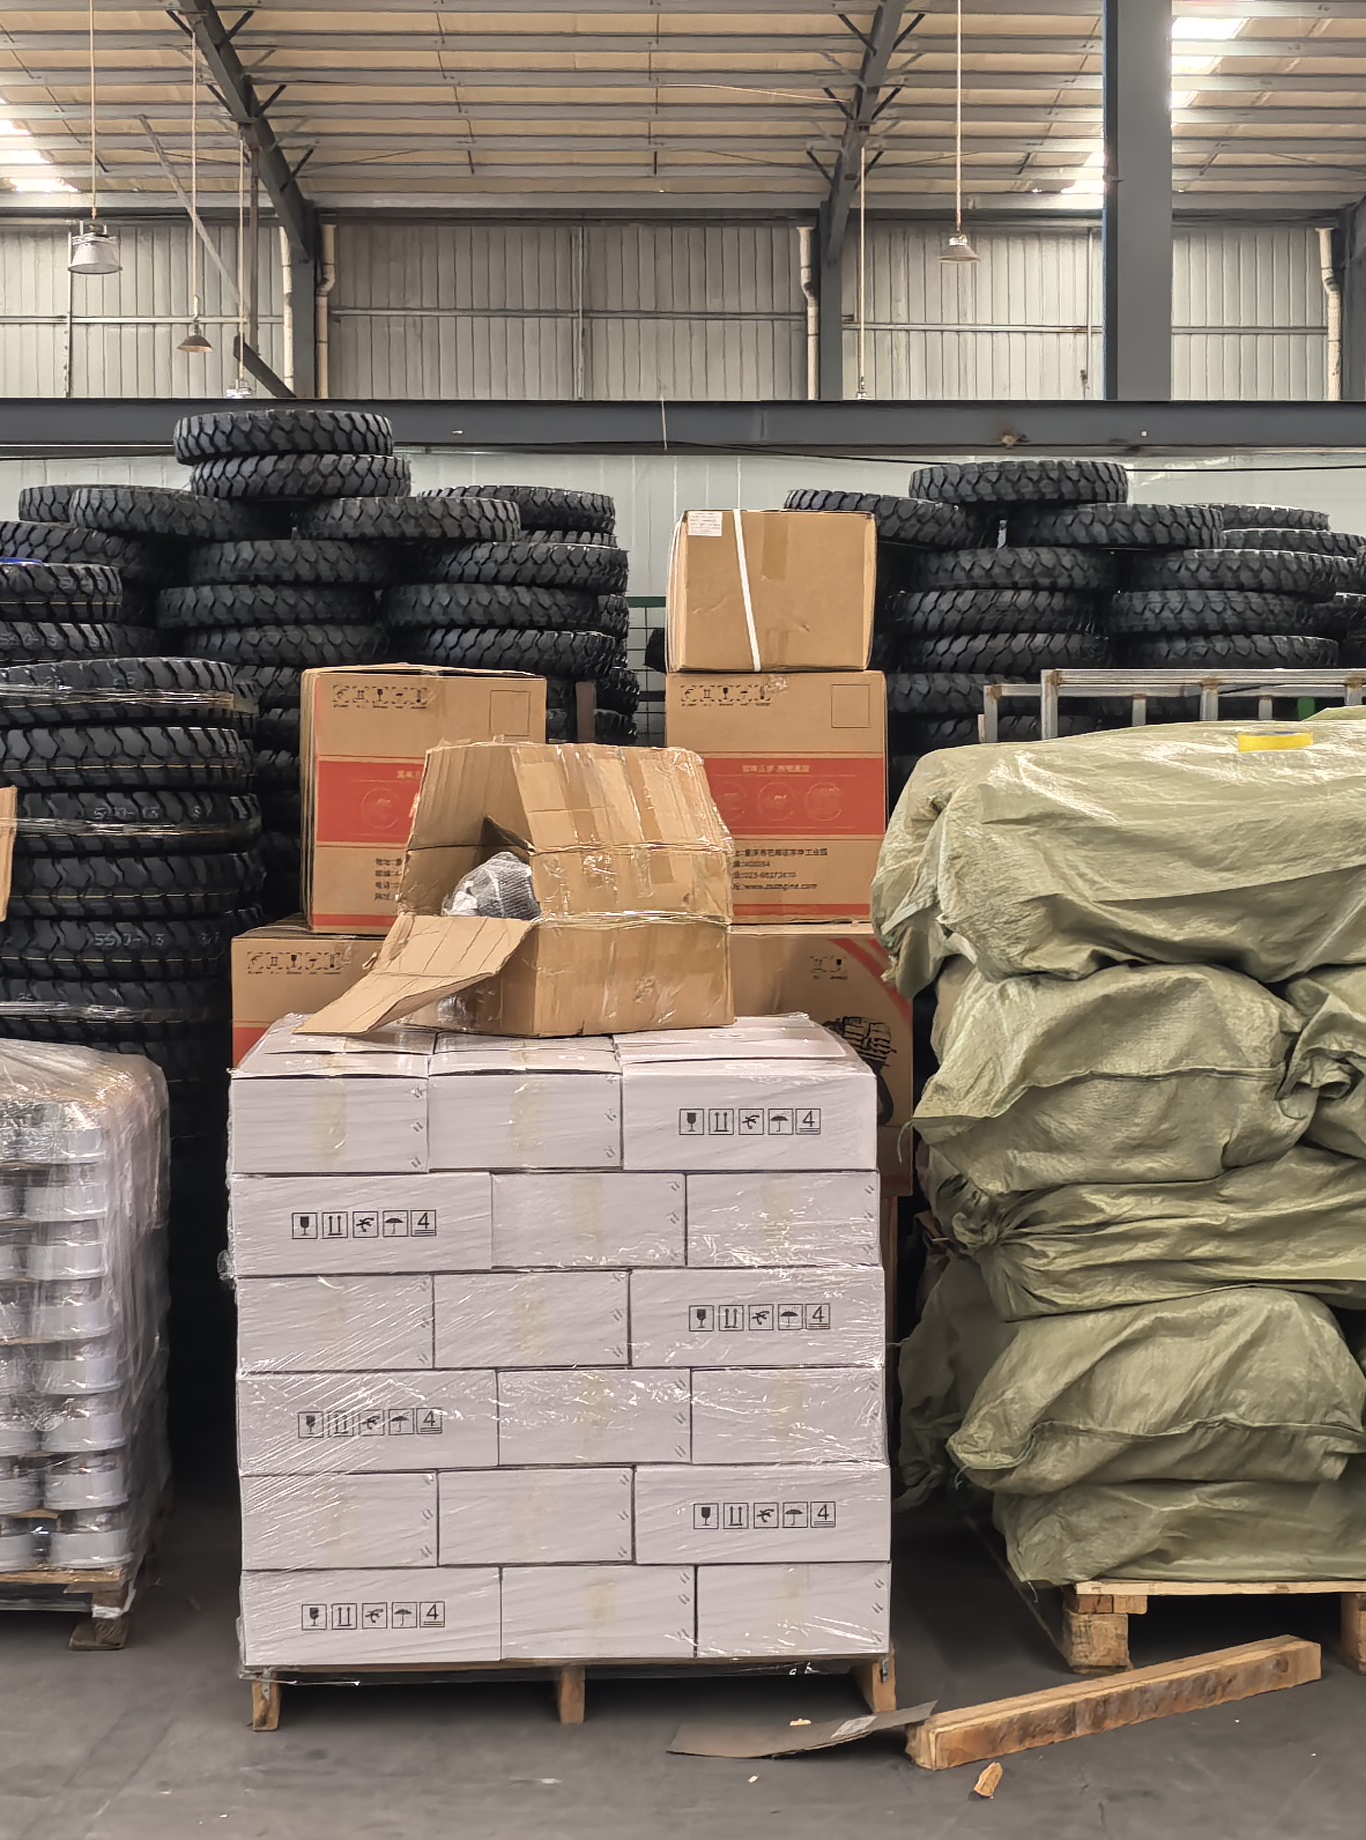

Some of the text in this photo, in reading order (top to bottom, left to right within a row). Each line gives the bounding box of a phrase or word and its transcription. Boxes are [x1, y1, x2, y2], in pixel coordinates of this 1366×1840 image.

[801, 1110, 816, 1127] 4
[417, 1212, 430, 1229] 4
[812, 1306, 825, 1323] 4
[423, 1409, 436, 1426] 4
[817, 1503, 831, 1520] 4
[426, 1603, 440, 1620] 4
